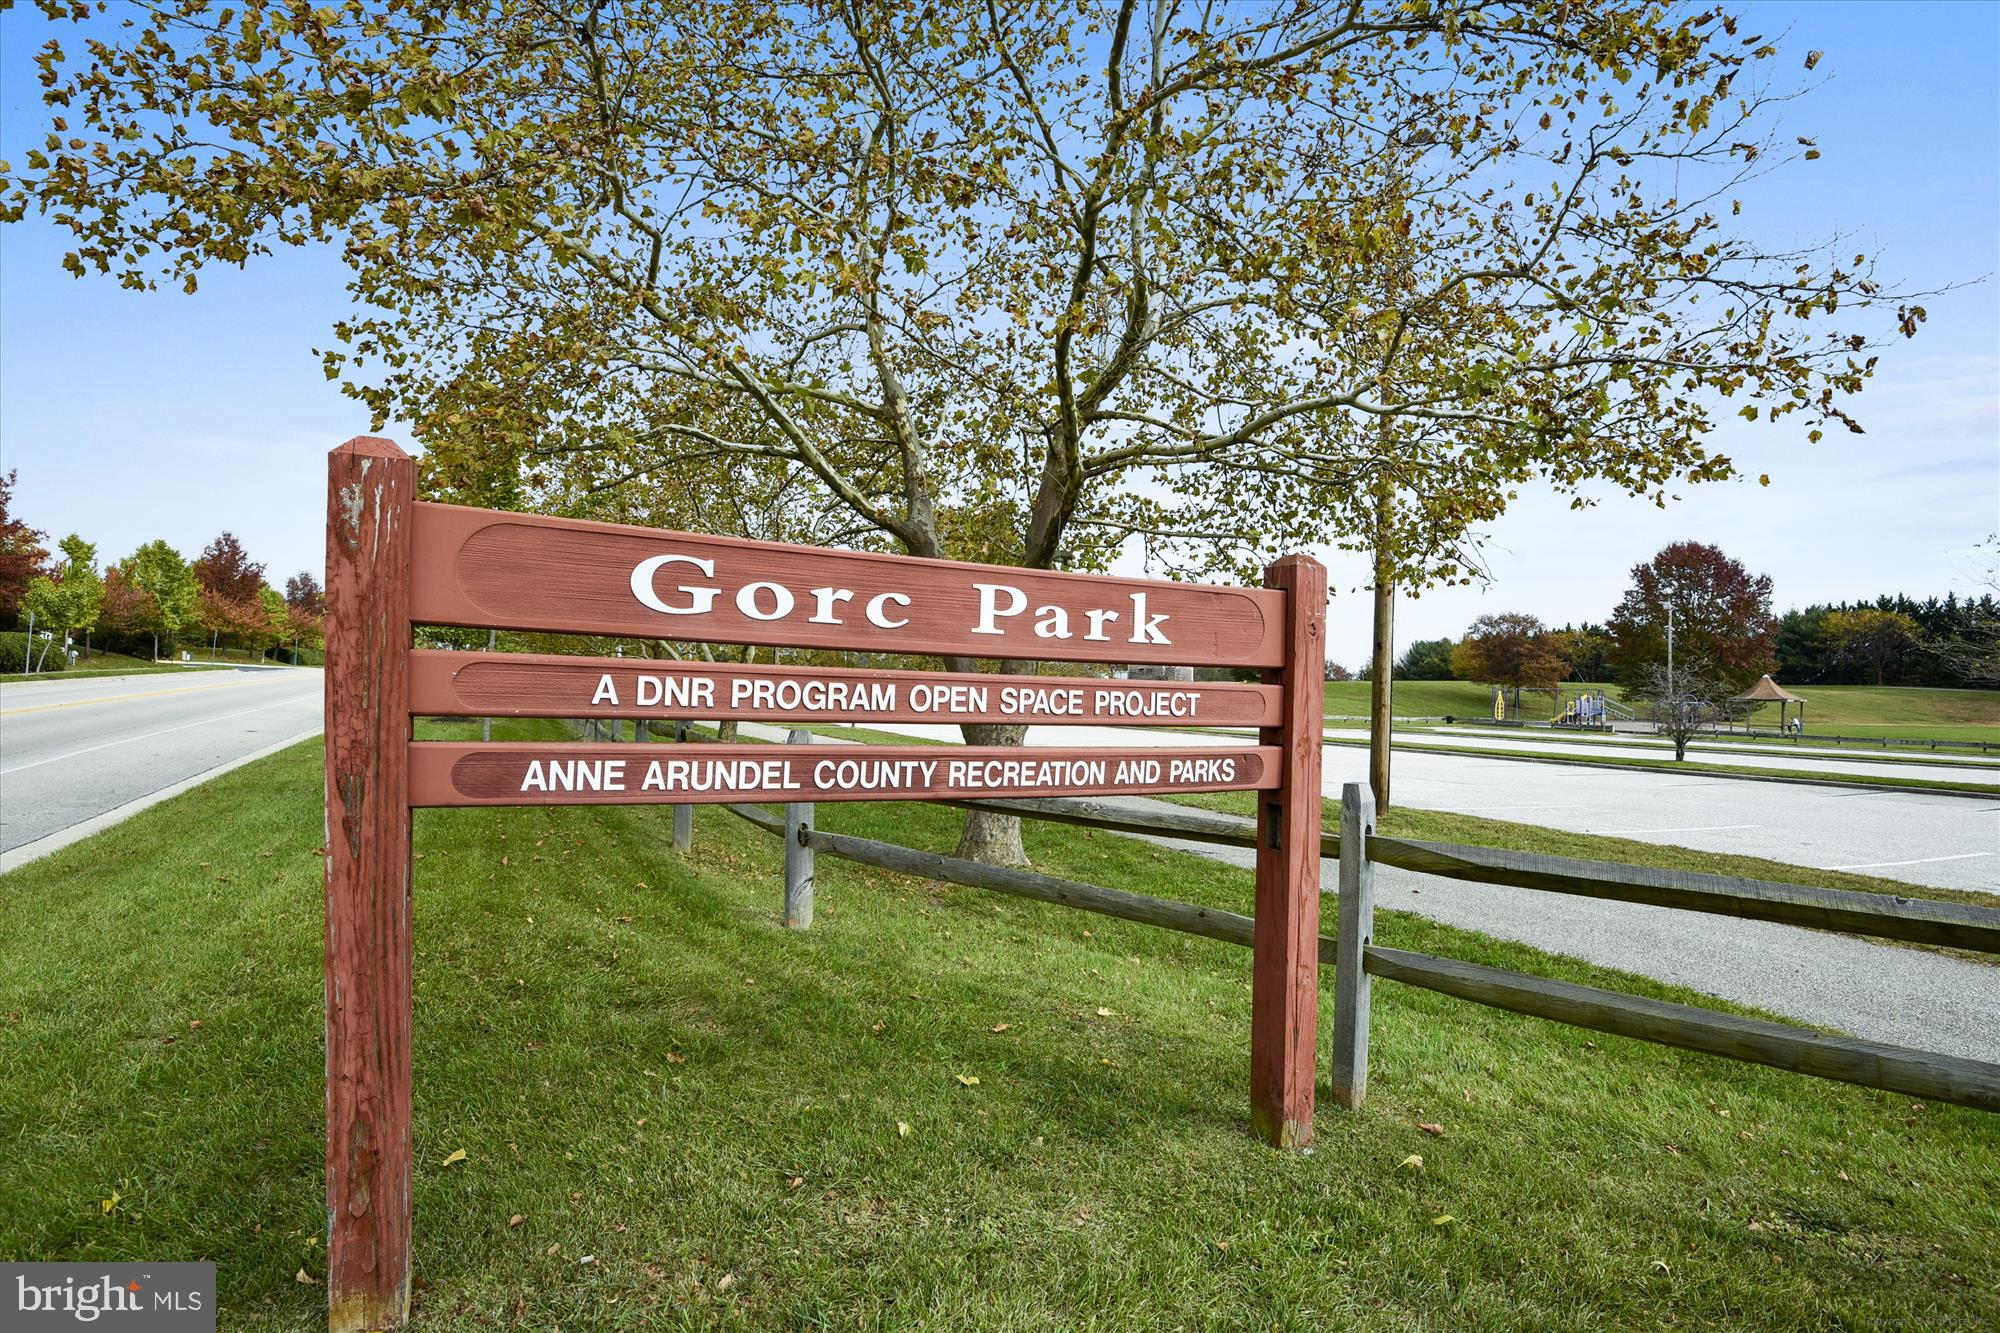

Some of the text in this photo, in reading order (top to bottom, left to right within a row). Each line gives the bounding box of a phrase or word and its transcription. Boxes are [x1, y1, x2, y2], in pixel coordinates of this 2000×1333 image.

[631, 554, 1172, 645] Gorc Park
[591, 674, 1201, 717] A DNR PROGRAM OPEN SPACE PROJECT
[520, 758, 1236, 791] ANNE ARUNDEL COUNTY RECREATION AND PARKS
